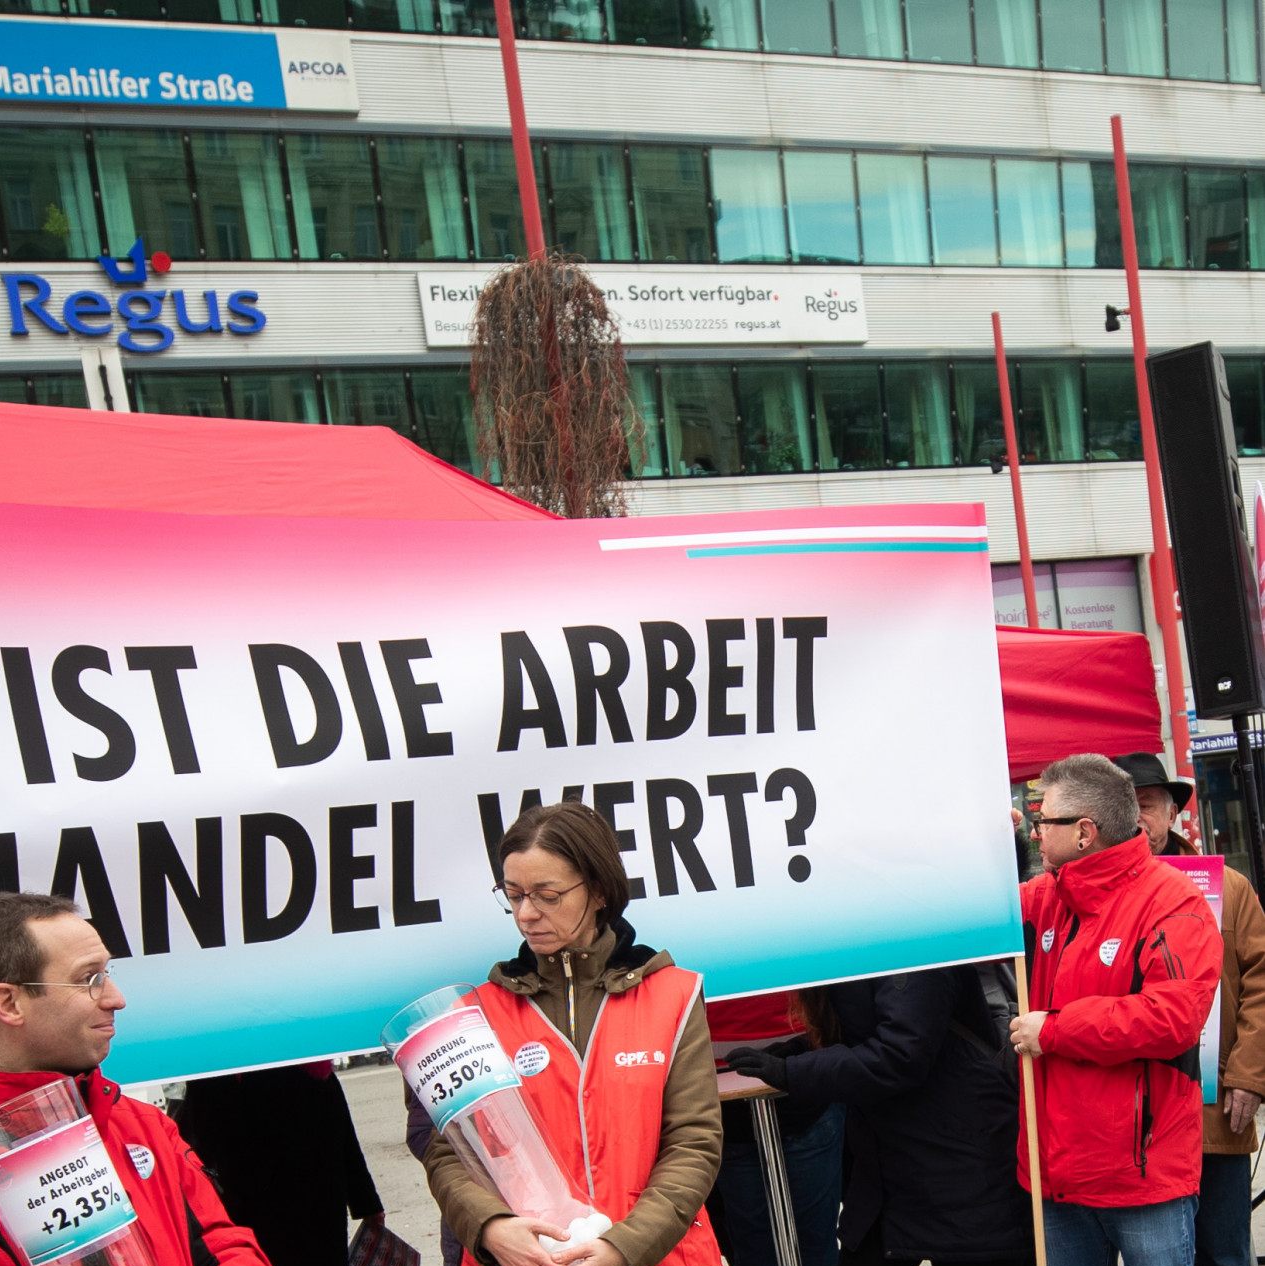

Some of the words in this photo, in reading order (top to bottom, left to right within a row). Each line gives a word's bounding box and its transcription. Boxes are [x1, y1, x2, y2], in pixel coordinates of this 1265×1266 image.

[288, 60, 347, 76] APCOA
[159, 72, 255, 102] Straße
[628, 286, 683, 301] Sofort
[689, 284, 779, 305] verfügbar.
[805, 296, 858, 320] Regus
[1, 273, 266, 353] Regus
[627, 318, 647, 329] +43
[649, 318, 663, 330] (1)
[734, 320, 781, 331] regus.at
[1065, 602, 1115, 615] Kostenlose
[1071, 617, 1113, 629] Beratung
[0, 644, 201, 785] IST
[248, 638, 454, 769] DIE
[496, 616, 828, 752] ARBEIT
[1190, 736, 1238, 750] ariahilf
[417, 1036, 467, 1071] FORDERUNG
[419, 1042, 495, 1087] ArbeitnehmerInnen
[431, 1057, 492, 1106] +3,50%
[39, 1156, 89, 1187] ANGEBOT
[27, 1197, 47, 1210] der
[49, 1166, 108, 1200] Arbeitgeber
[42, 1182, 121, 1235] +2,35%
